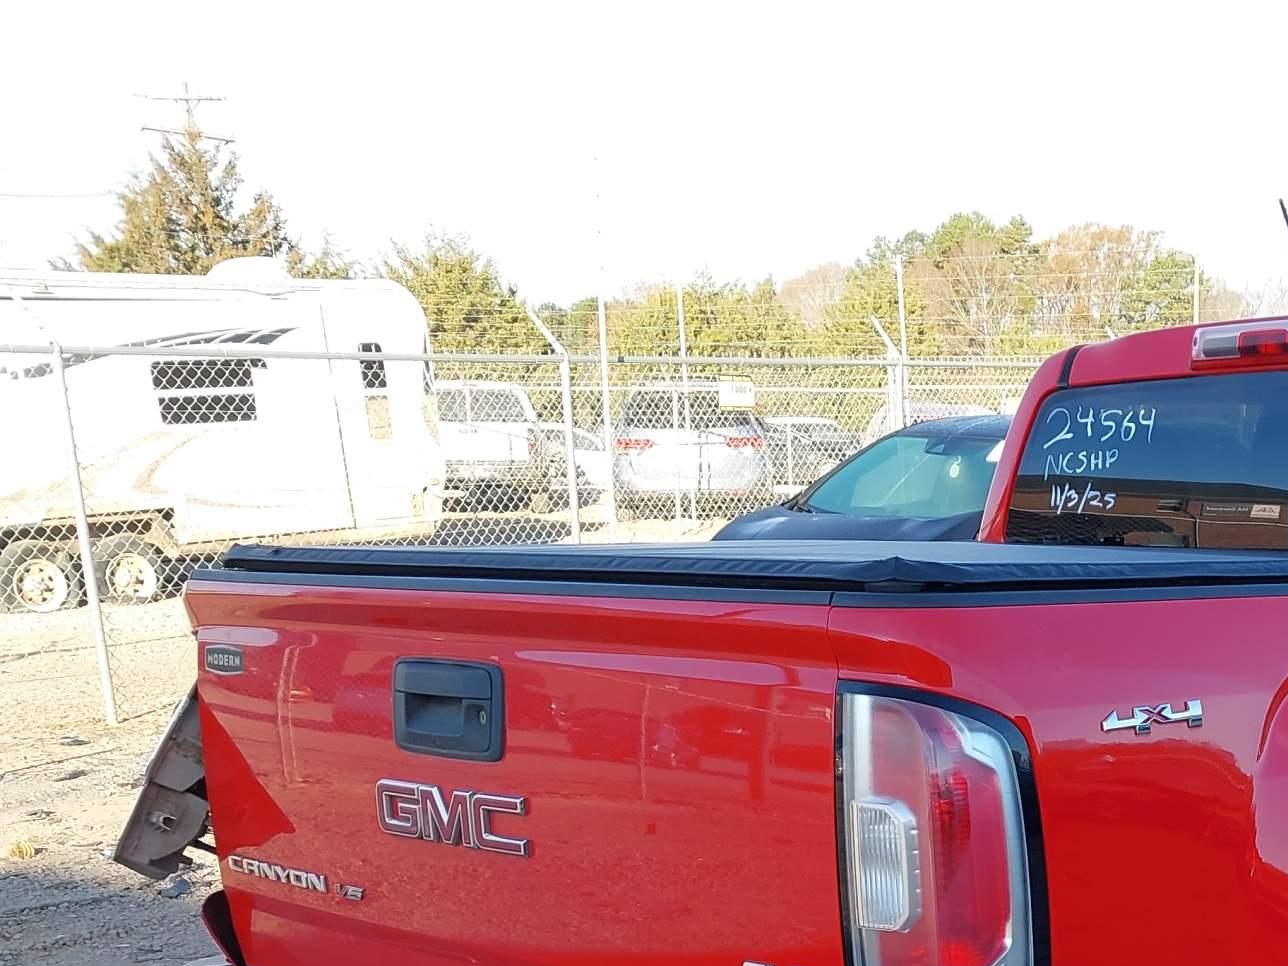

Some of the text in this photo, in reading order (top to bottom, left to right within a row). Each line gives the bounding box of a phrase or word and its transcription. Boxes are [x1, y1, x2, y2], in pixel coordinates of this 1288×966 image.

[1043, 406, 1156, 449] 24564
[1044, 449, 1119, 481] NCSHP
[1050, 482, 1117, 515] 11/3/25
[207, 653, 240, 667] MODERN
[375, 778, 529, 857] GMC
[227, 854, 328, 893] CANYON
